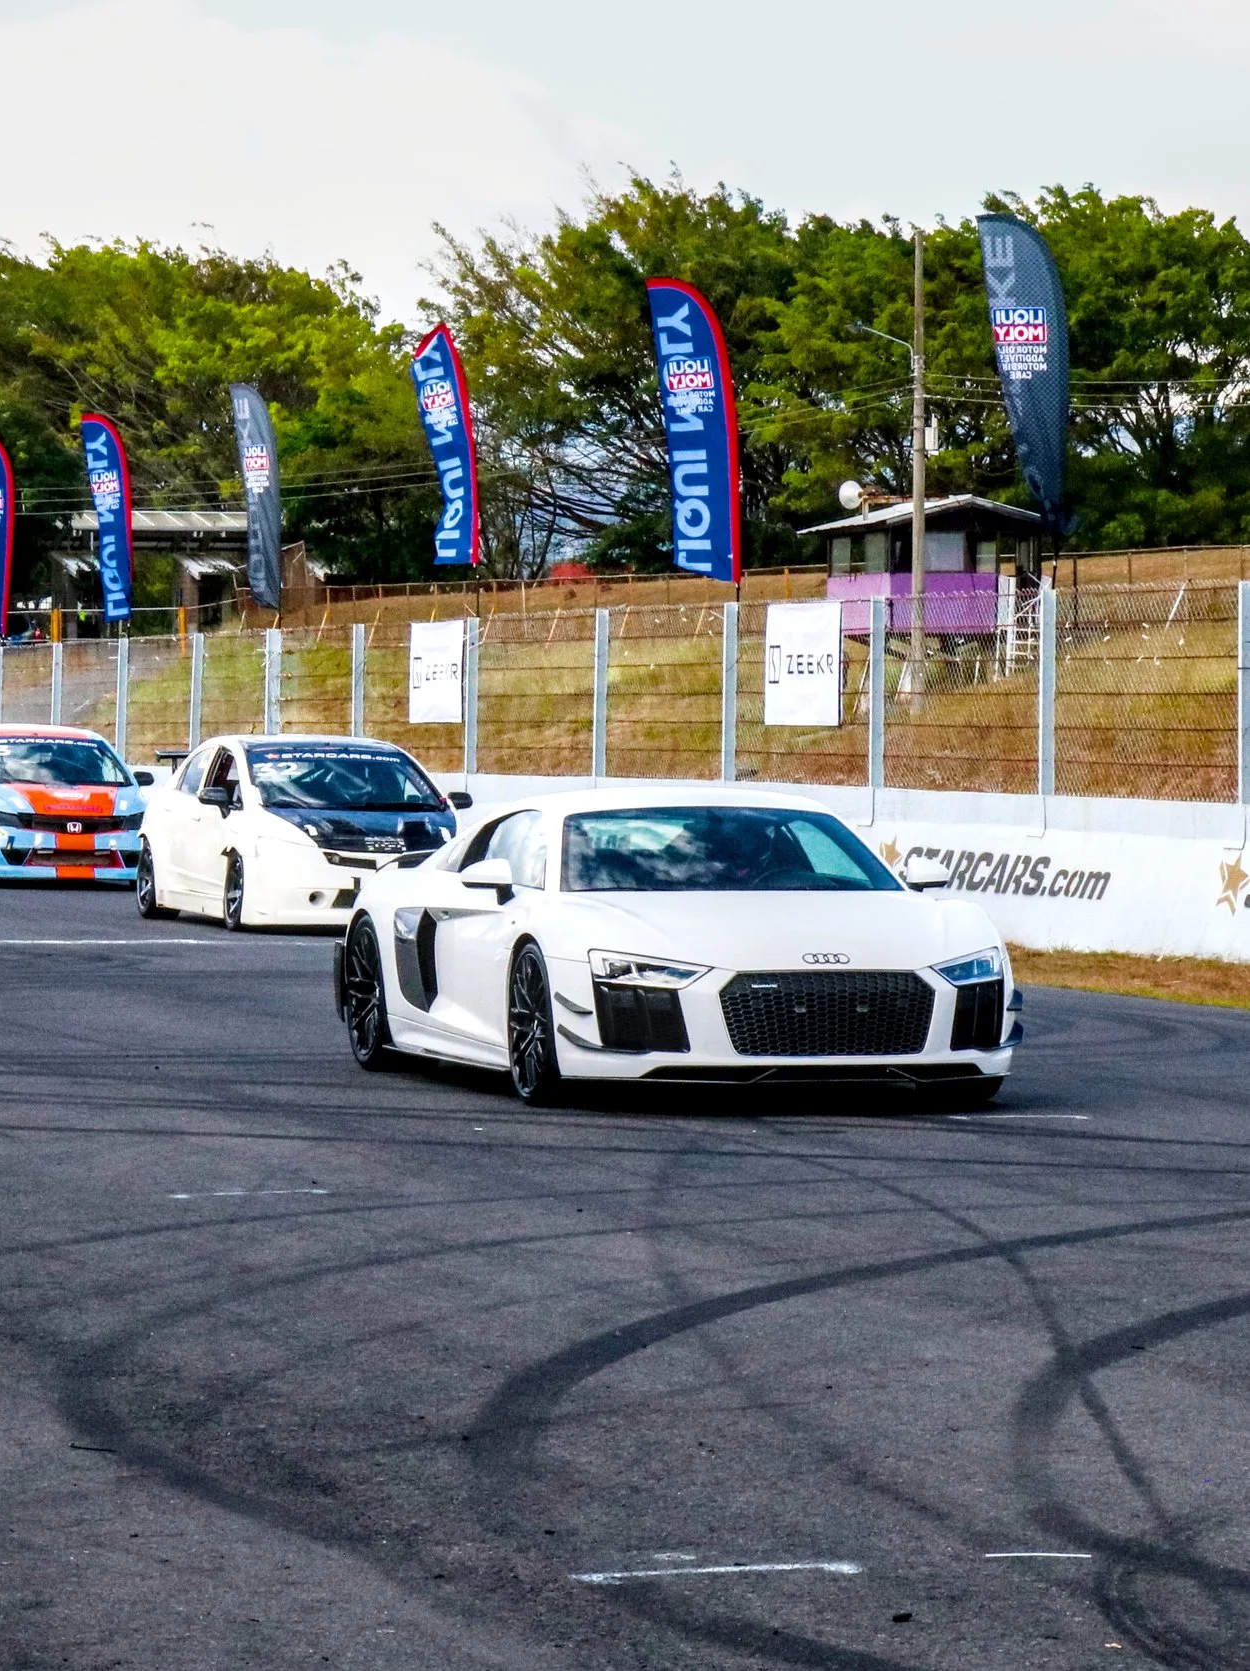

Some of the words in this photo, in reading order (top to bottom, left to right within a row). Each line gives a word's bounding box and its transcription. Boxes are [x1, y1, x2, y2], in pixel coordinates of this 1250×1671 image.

[786, 653, 834, 674] ZEEKR
[281, 752, 400, 762] STARCARS.com
[253, 762, 298, 777] 32
